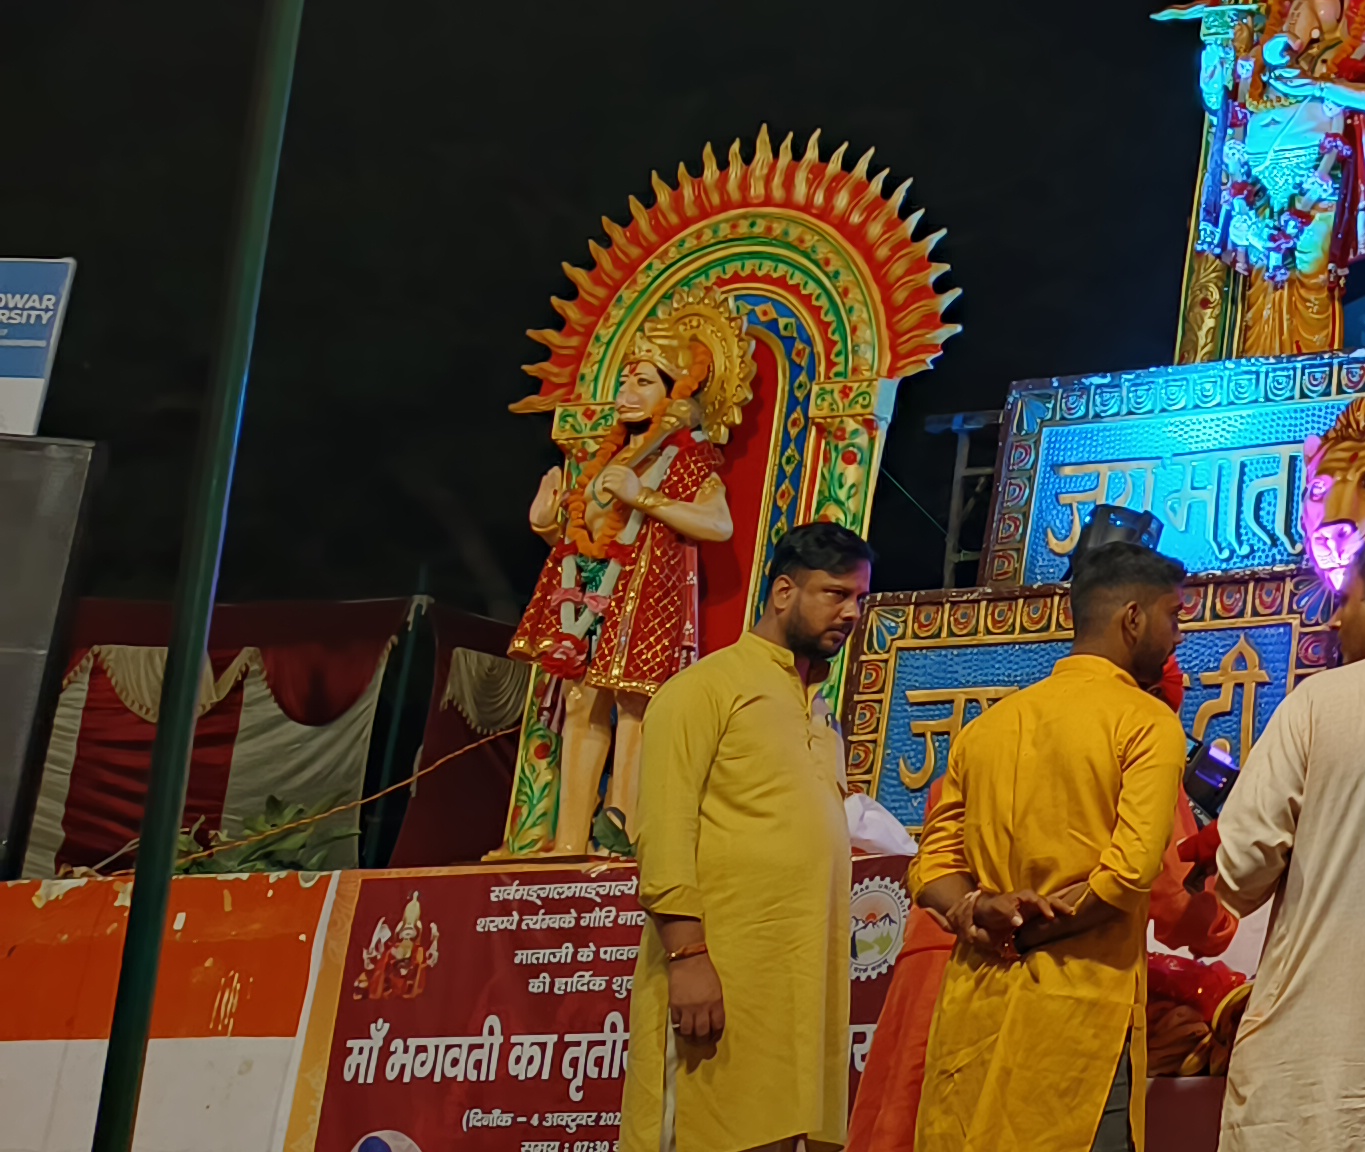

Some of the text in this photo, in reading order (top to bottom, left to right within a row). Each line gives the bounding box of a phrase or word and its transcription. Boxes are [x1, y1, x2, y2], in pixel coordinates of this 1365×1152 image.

[514, 942, 574, 965] माताजी
[577, 942, 596, 962] के
[528, 972, 551, 994] की
[553, 970, 609, 995] हार्दिक
[343, 1011, 631, 1102] माँ भगवती का तृती
[530, 1112, 540, 1127] 4
[599, 1111, 622, 1126] 202
